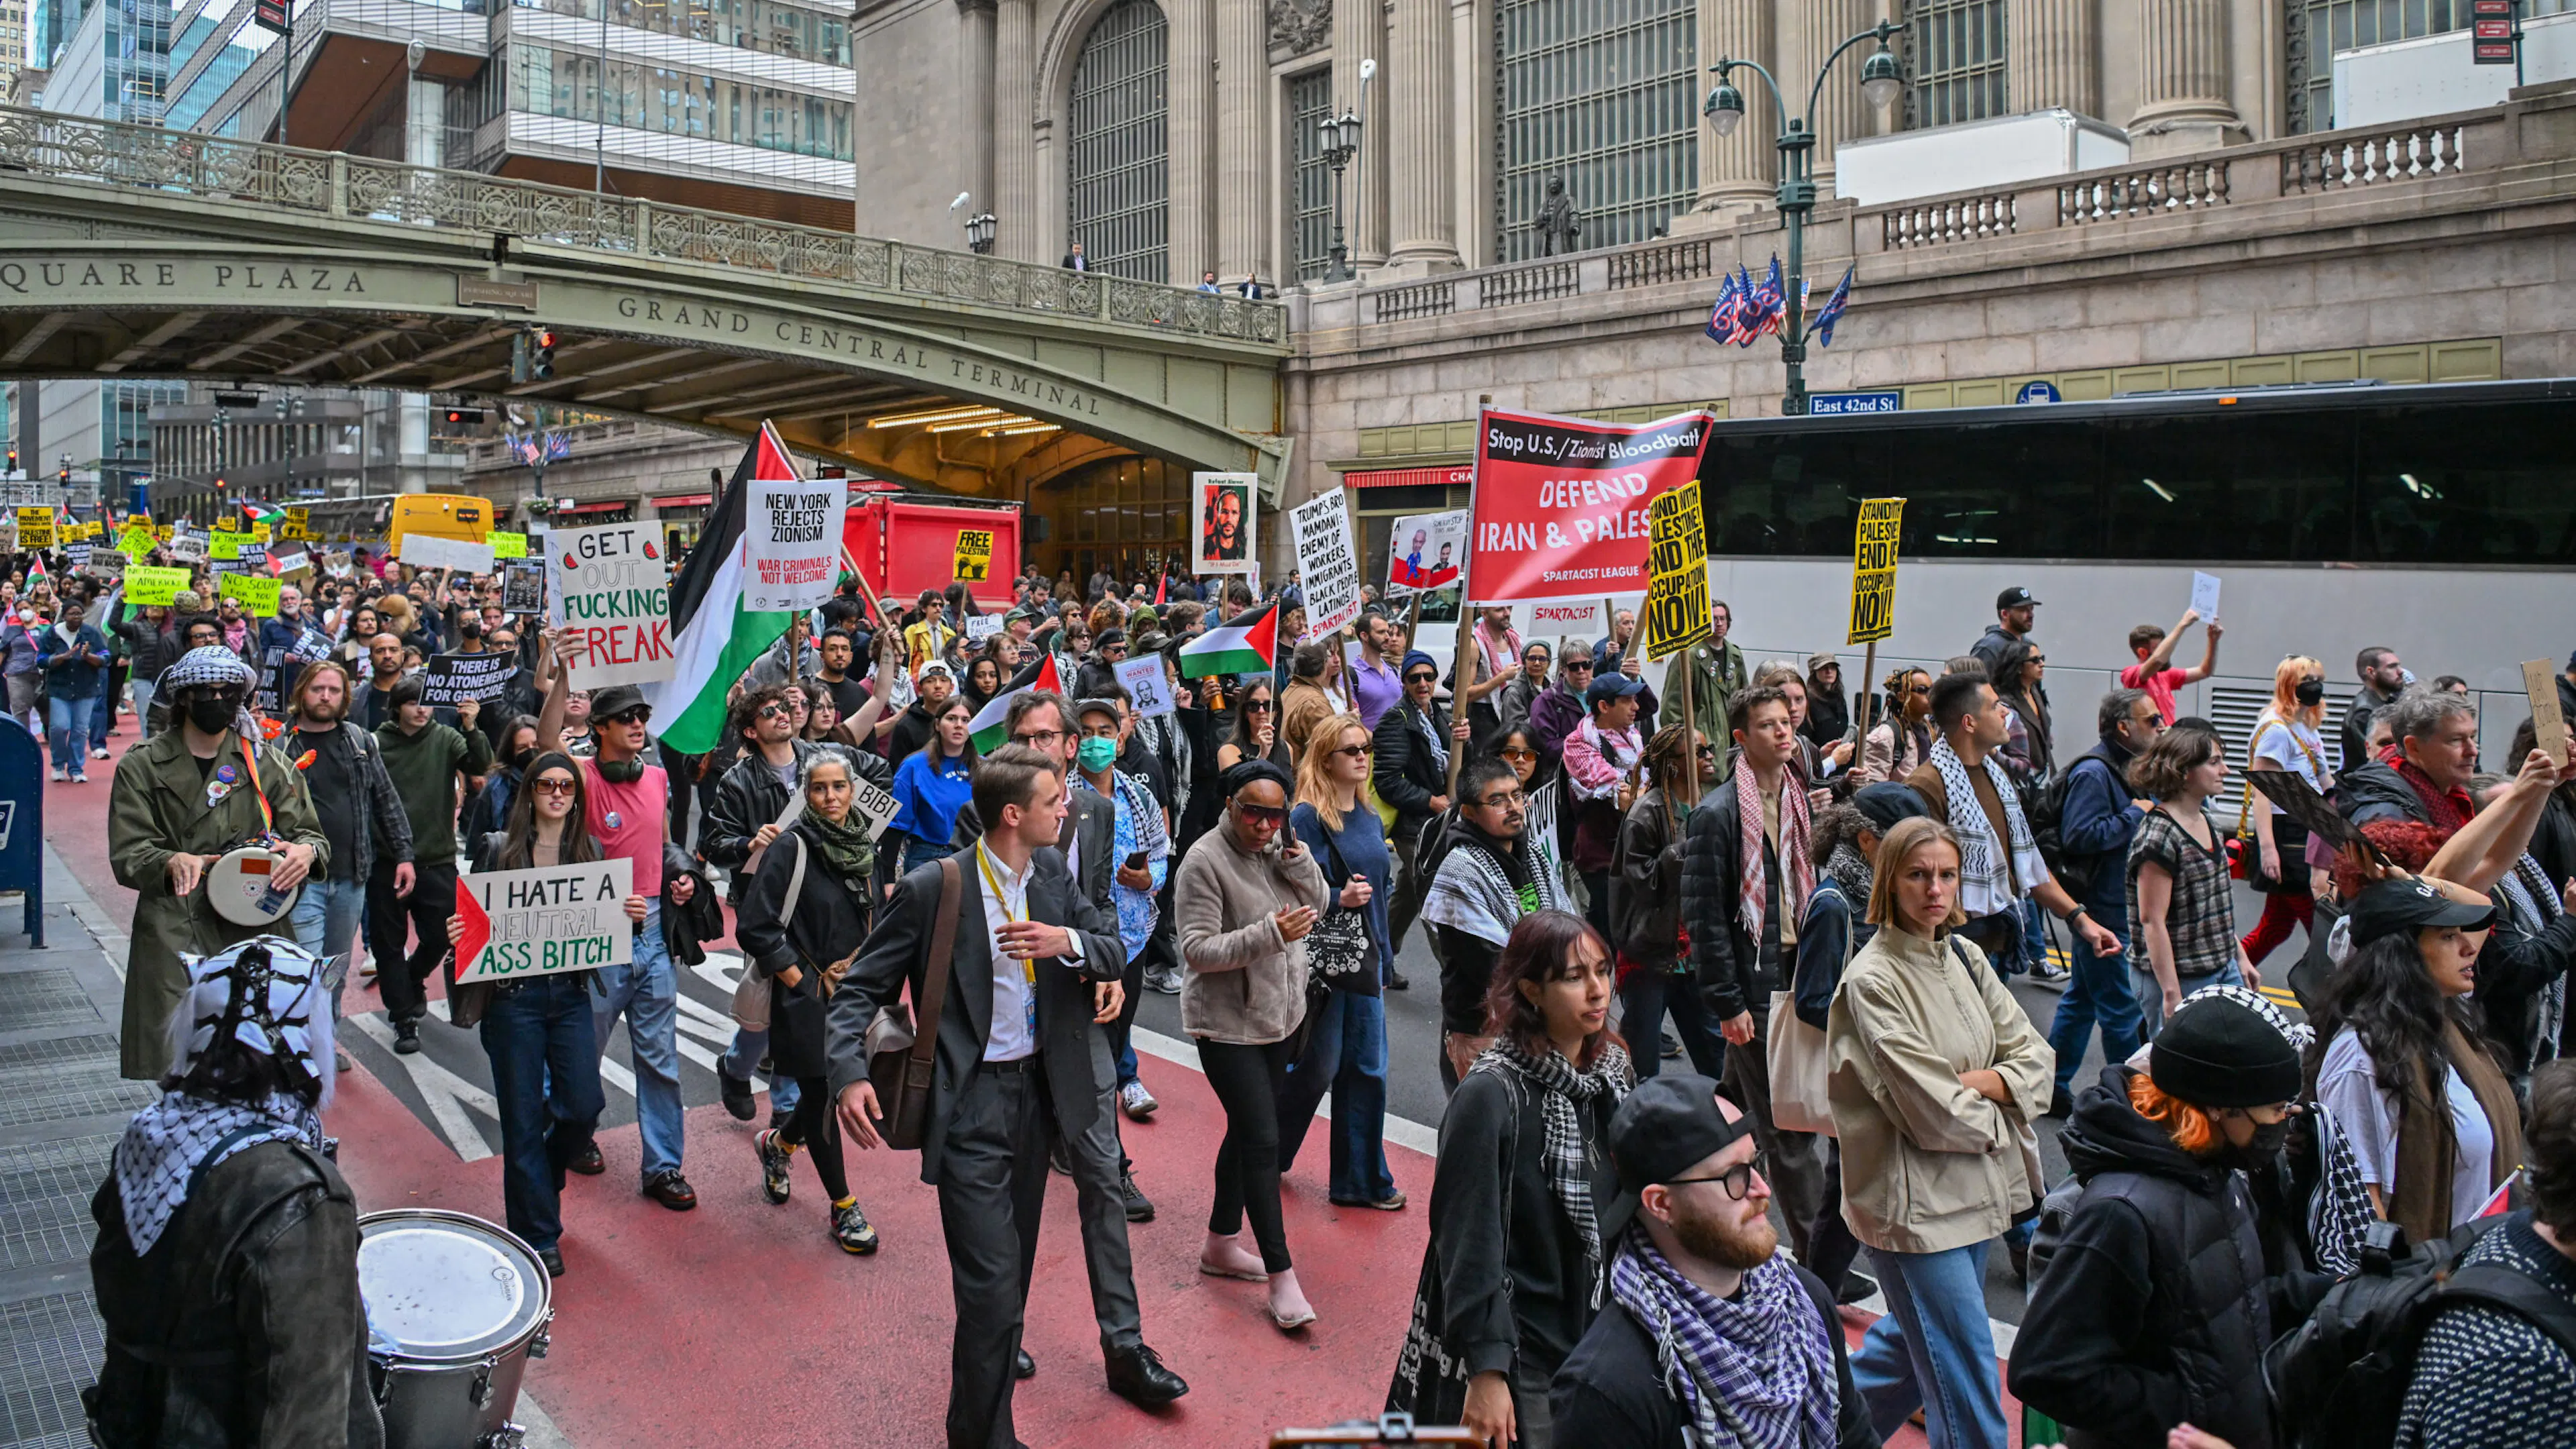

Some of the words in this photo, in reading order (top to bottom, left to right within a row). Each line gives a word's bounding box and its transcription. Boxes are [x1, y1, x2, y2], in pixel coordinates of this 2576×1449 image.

[215, 266, 365, 292] PLAZA
[619, 298, 749, 333] GRAND
[776, 322, 927, 368] CENTRAL
[951, 359, 1099, 415] TERMINAL
[1814, 400, 1842, 413] East
[1845, 399, 1876, 412] 42nd
[1879, 398, 1894, 411] St
[1489, 428, 1524, 455] Stop
[765, 494, 796, 509] NEW
[800, 493, 831, 509] YORK
[1539, 473, 1648, 508] DEFEND
[1678, 486, 1698, 511] WITH
[290, 508, 306, 517] FREE
[772, 510, 824, 526] REJECTS
[1297, 500, 1330, 523] TRUMP'S
[1330, 494, 1344, 511] BRO
[1451, 515, 1463, 525] STOP
[1862, 502, 1890, 520] STAND
[771, 526, 822, 543] ZIONISM
[959, 531, 991, 547] FREE
[1302, 515, 1342, 540] MAMDANI:
[1479, 522, 1537, 552] IRAN
[1546, 522, 1572, 548] &
[579, 530, 635, 559] GET
[955, 546, 991, 556] PALESTINE
[1301, 536, 1329, 559] ENEMY
[1331, 529, 1340, 545] OF
[1685, 528, 1705, 564] THE
[1858, 542, 1887, 570] END
[757, 559, 780, 572] WAR
[784, 555, 832, 572] CRIMINALS
[1308, 544, 1346, 572] WORKERS
[223, 574, 242, 586] NO
[248, 578, 278, 590] SOUP
[582, 559, 640, 589] OUT
[761, 572, 781, 584] NOT
[784, 568, 827, 584] WELCOME
[1306, 557, 1352, 590] IMMIGRANTS
[1542, 568, 1599, 582] SPARTACIST
[1601, 566, 1640, 578] LEAGUE
[230, 589, 248, 597] FOR
[1310, 583, 1335, 606] BLACK
[1337, 571, 1358, 595] PEOPLE
[564, 588, 667, 620] FUCKING
[1319, 586, 1354, 618] LATINOS!
[1536, 606, 1595, 622] SPARTACIST
[1650, 584, 1707, 645] NOW!
[1312, 601, 1358, 637] SPARTACIST
[567, 619, 674, 669] FREAK
[426, 674, 446, 688] NO
[446, 668, 511, 688] ATONEMENT
[451, 659, 490, 674] THERE
[490, 657, 501, 671] IS
[1127, 665, 1155, 678] WANTED
[425, 689, 451, 702] FOR
[453, 682, 505, 702] GENOCIDE
[858, 784, 897, 818] BIBI
[486, 882, 490, 911] I
[508, 877, 585, 908] HATE
[596, 873, 616, 901] A
[490, 907, 606, 943] NEUTRAL
[479, 941, 532, 975] ASS
[543, 935, 612, 970] BITCH
